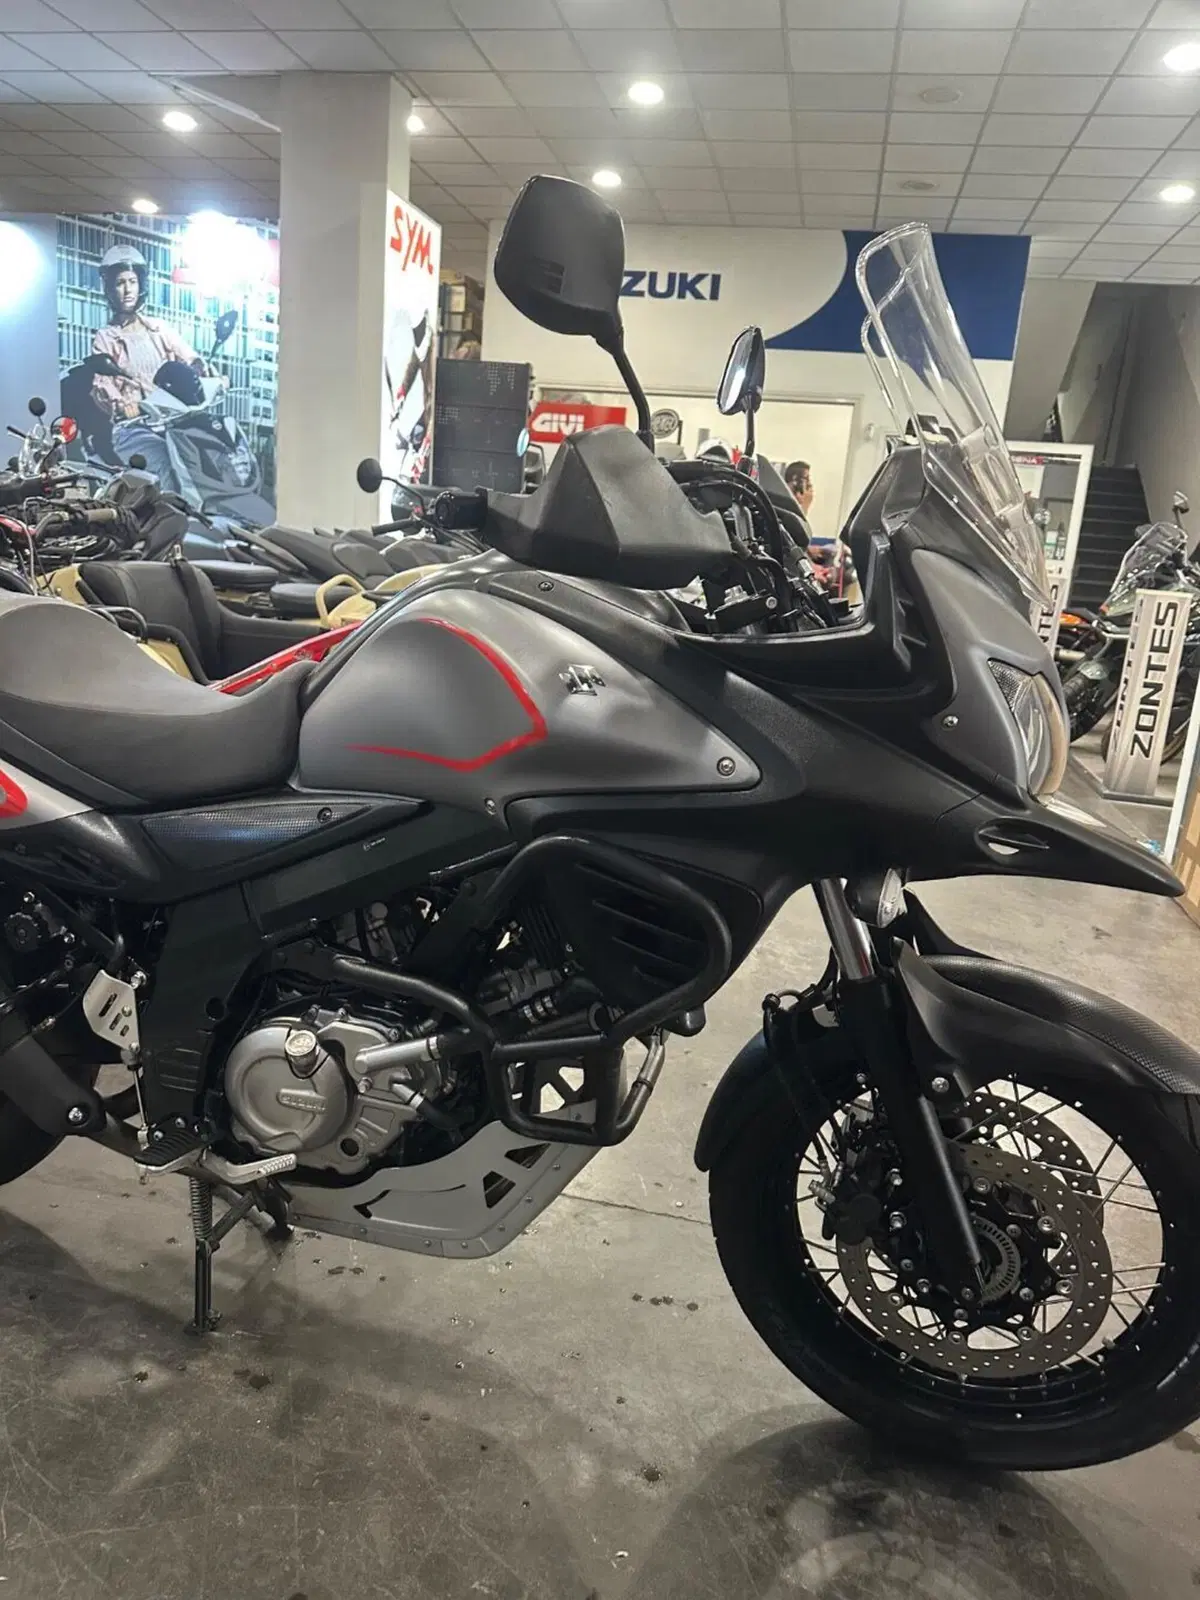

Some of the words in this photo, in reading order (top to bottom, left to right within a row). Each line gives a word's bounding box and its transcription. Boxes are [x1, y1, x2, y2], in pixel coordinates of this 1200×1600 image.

[390, 205, 434, 275] SYM
[619, 270, 722, 301] ZUKI
[532, 412, 585, 436] GIVI
[1130, 601, 1179, 759] ZONTES
